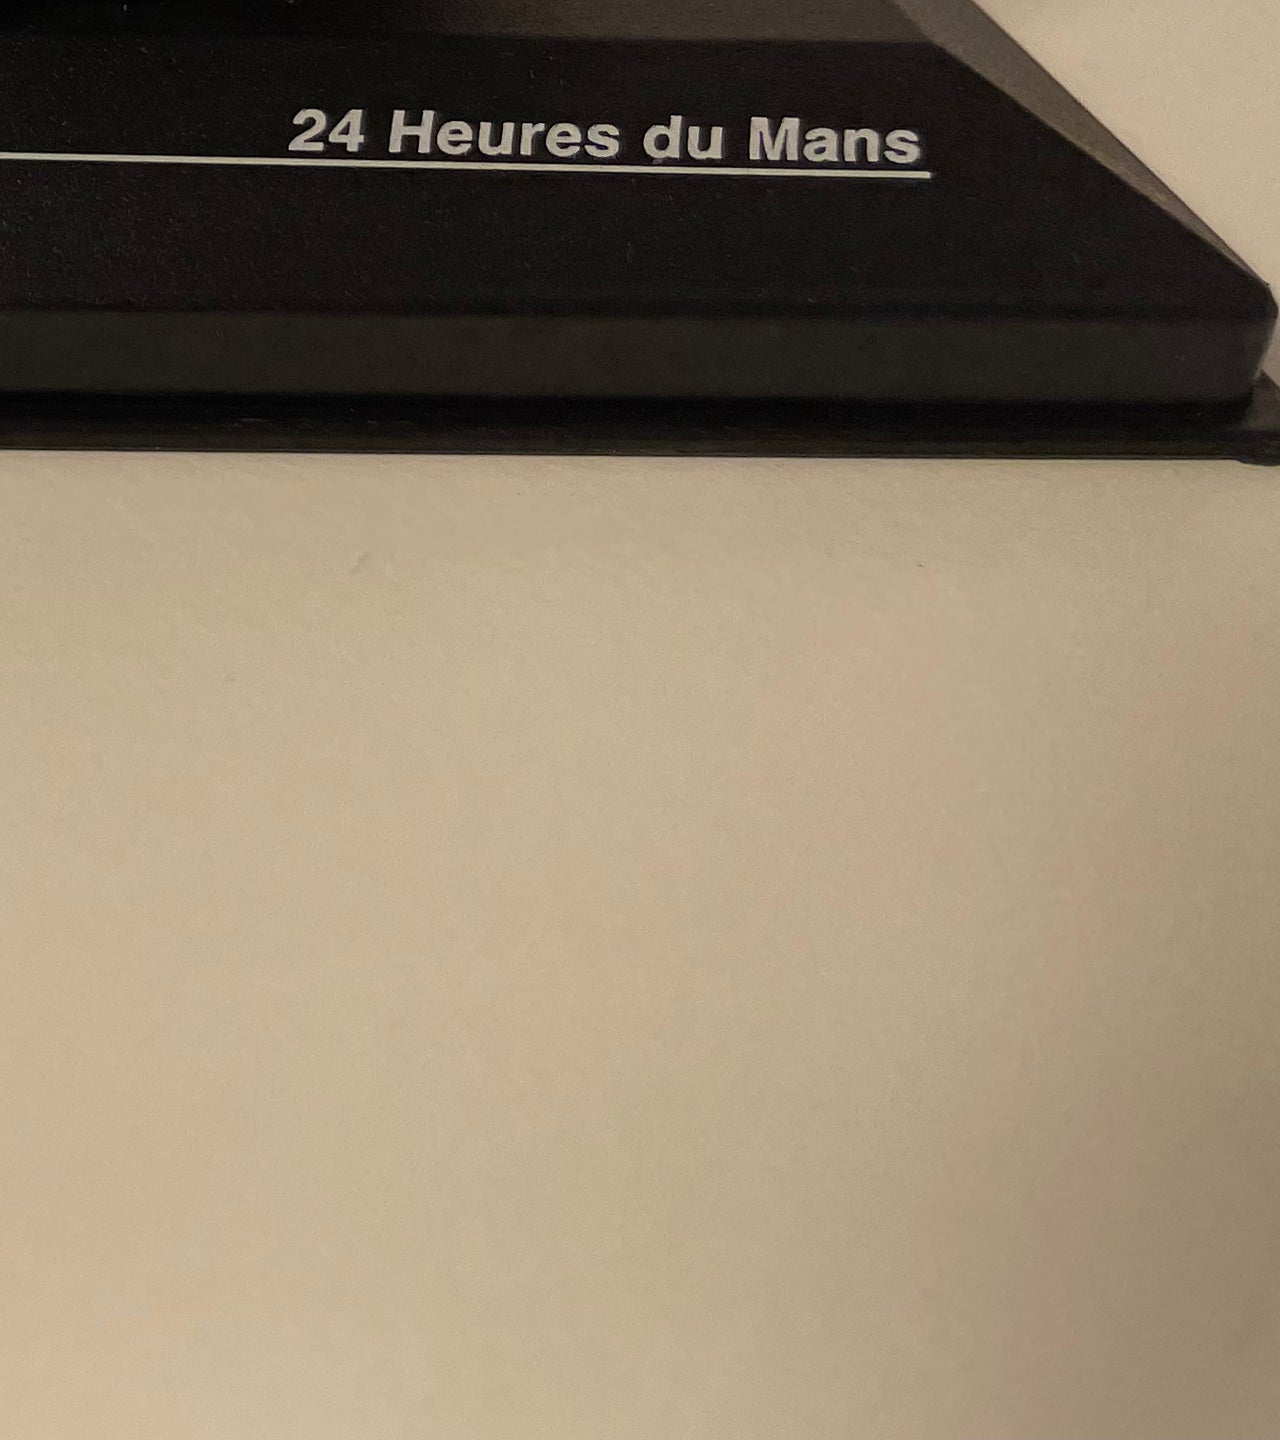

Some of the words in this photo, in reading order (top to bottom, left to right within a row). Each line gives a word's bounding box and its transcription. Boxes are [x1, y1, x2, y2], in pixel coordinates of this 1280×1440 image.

[287, 108, 366, 153] 24
[388, 109, 622, 159] Heures
[641, 114, 725, 161] du
[747, 116, 922, 163] Mans
